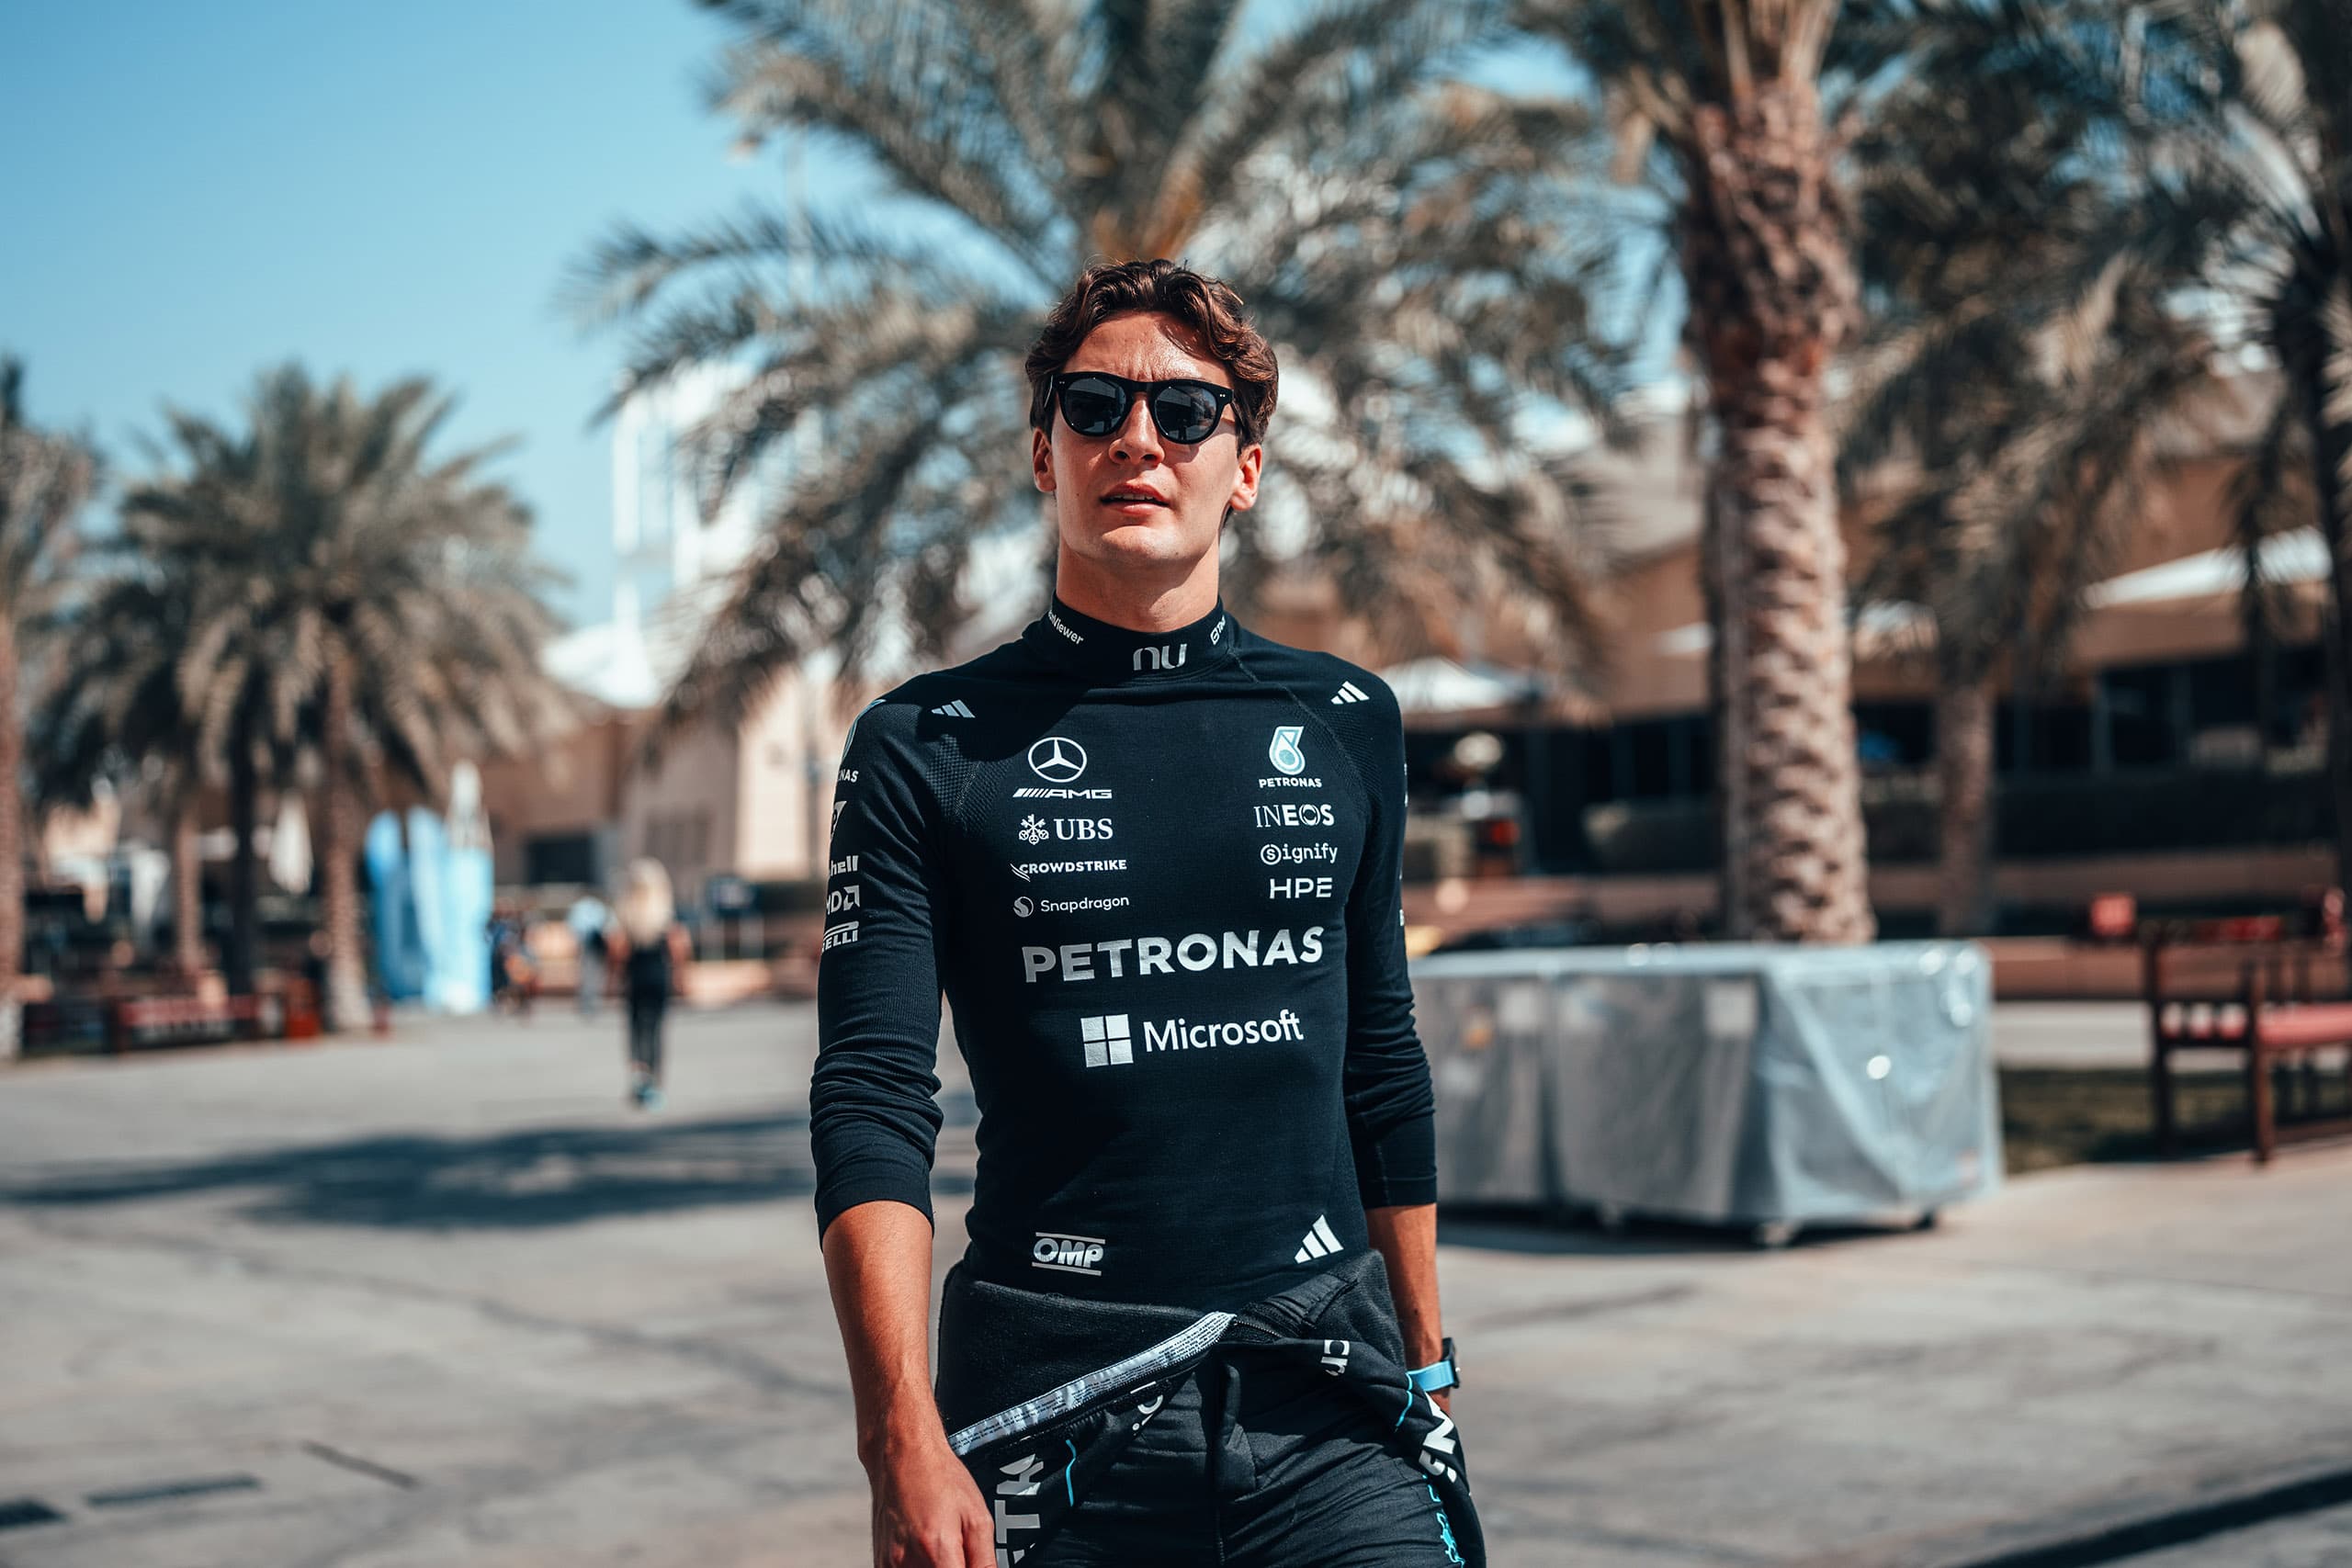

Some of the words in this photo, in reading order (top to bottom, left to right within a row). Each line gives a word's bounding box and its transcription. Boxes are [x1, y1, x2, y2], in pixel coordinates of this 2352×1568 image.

[1133, 643, 1187, 671] nu
[1259, 777, 1323, 788] PETRONAS
[1044, 789, 1113, 799] AMG
[1253, 804, 1335, 828] INEOS
[1054, 818, 1114, 840] UBS
[1019, 860, 1127, 875] CROWDSTRIKE
[1270, 877, 1332, 899] HPE
[1040, 897, 1130, 914] Snapdragon
[1021, 926, 1325, 983] PETRONAS
[1143, 1010, 1305, 1053] Microsoft
[1033, 1236, 1104, 1269] OMP
